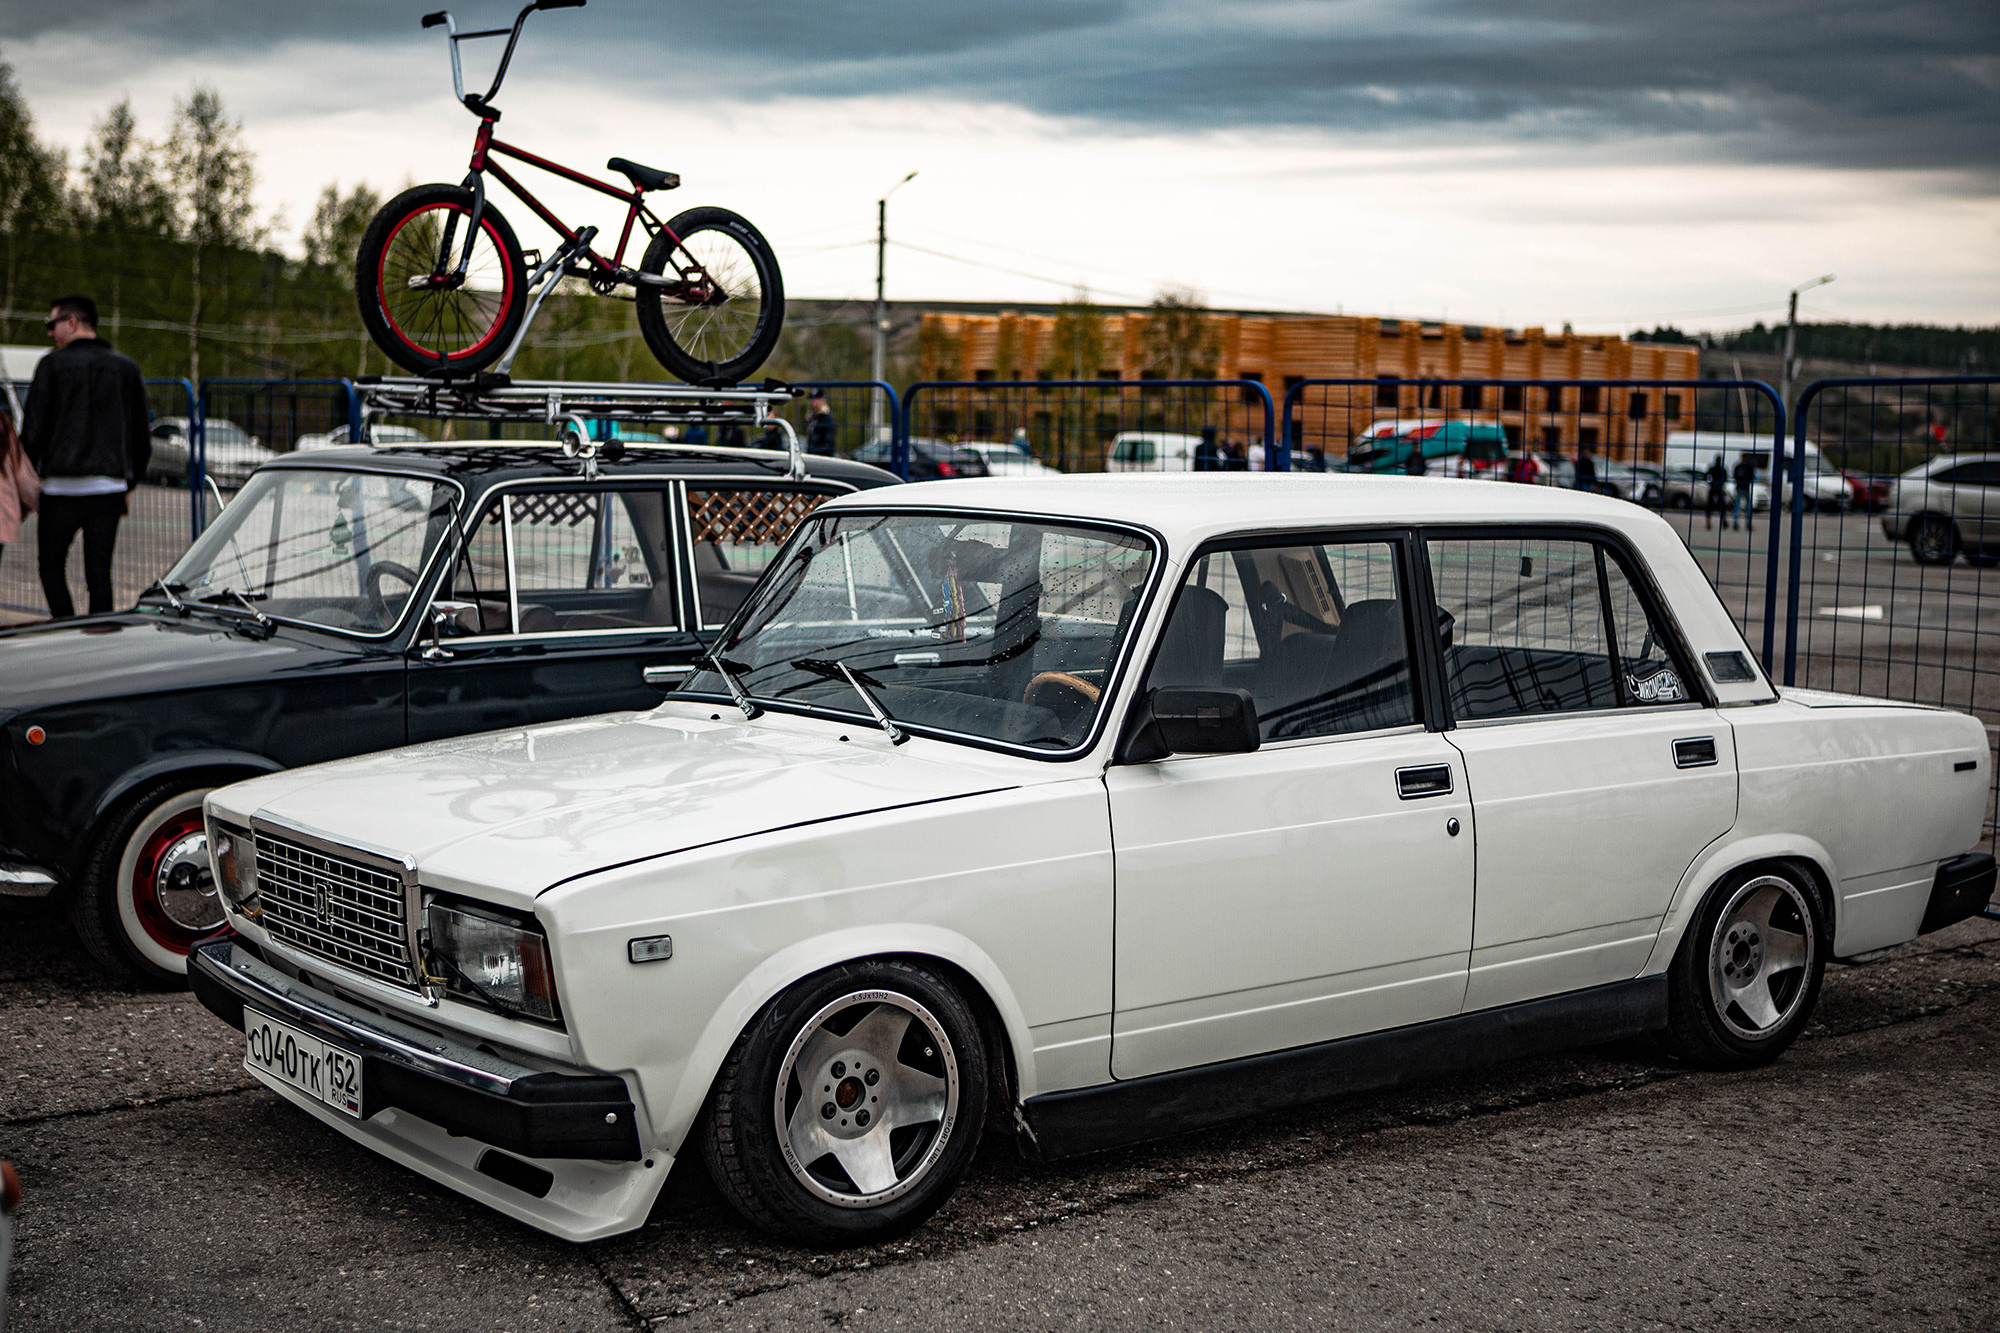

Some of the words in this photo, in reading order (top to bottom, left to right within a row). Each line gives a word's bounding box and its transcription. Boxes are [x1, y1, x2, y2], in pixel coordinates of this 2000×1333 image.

[325, 1049, 356, 1095] 152
[331, 1088, 348, 1106] RUS
[939, 1116, 954, 1145] SPORT
[783, 1142, 803, 1175] FUTURA
[926, 1147, 941, 1165] LINE
